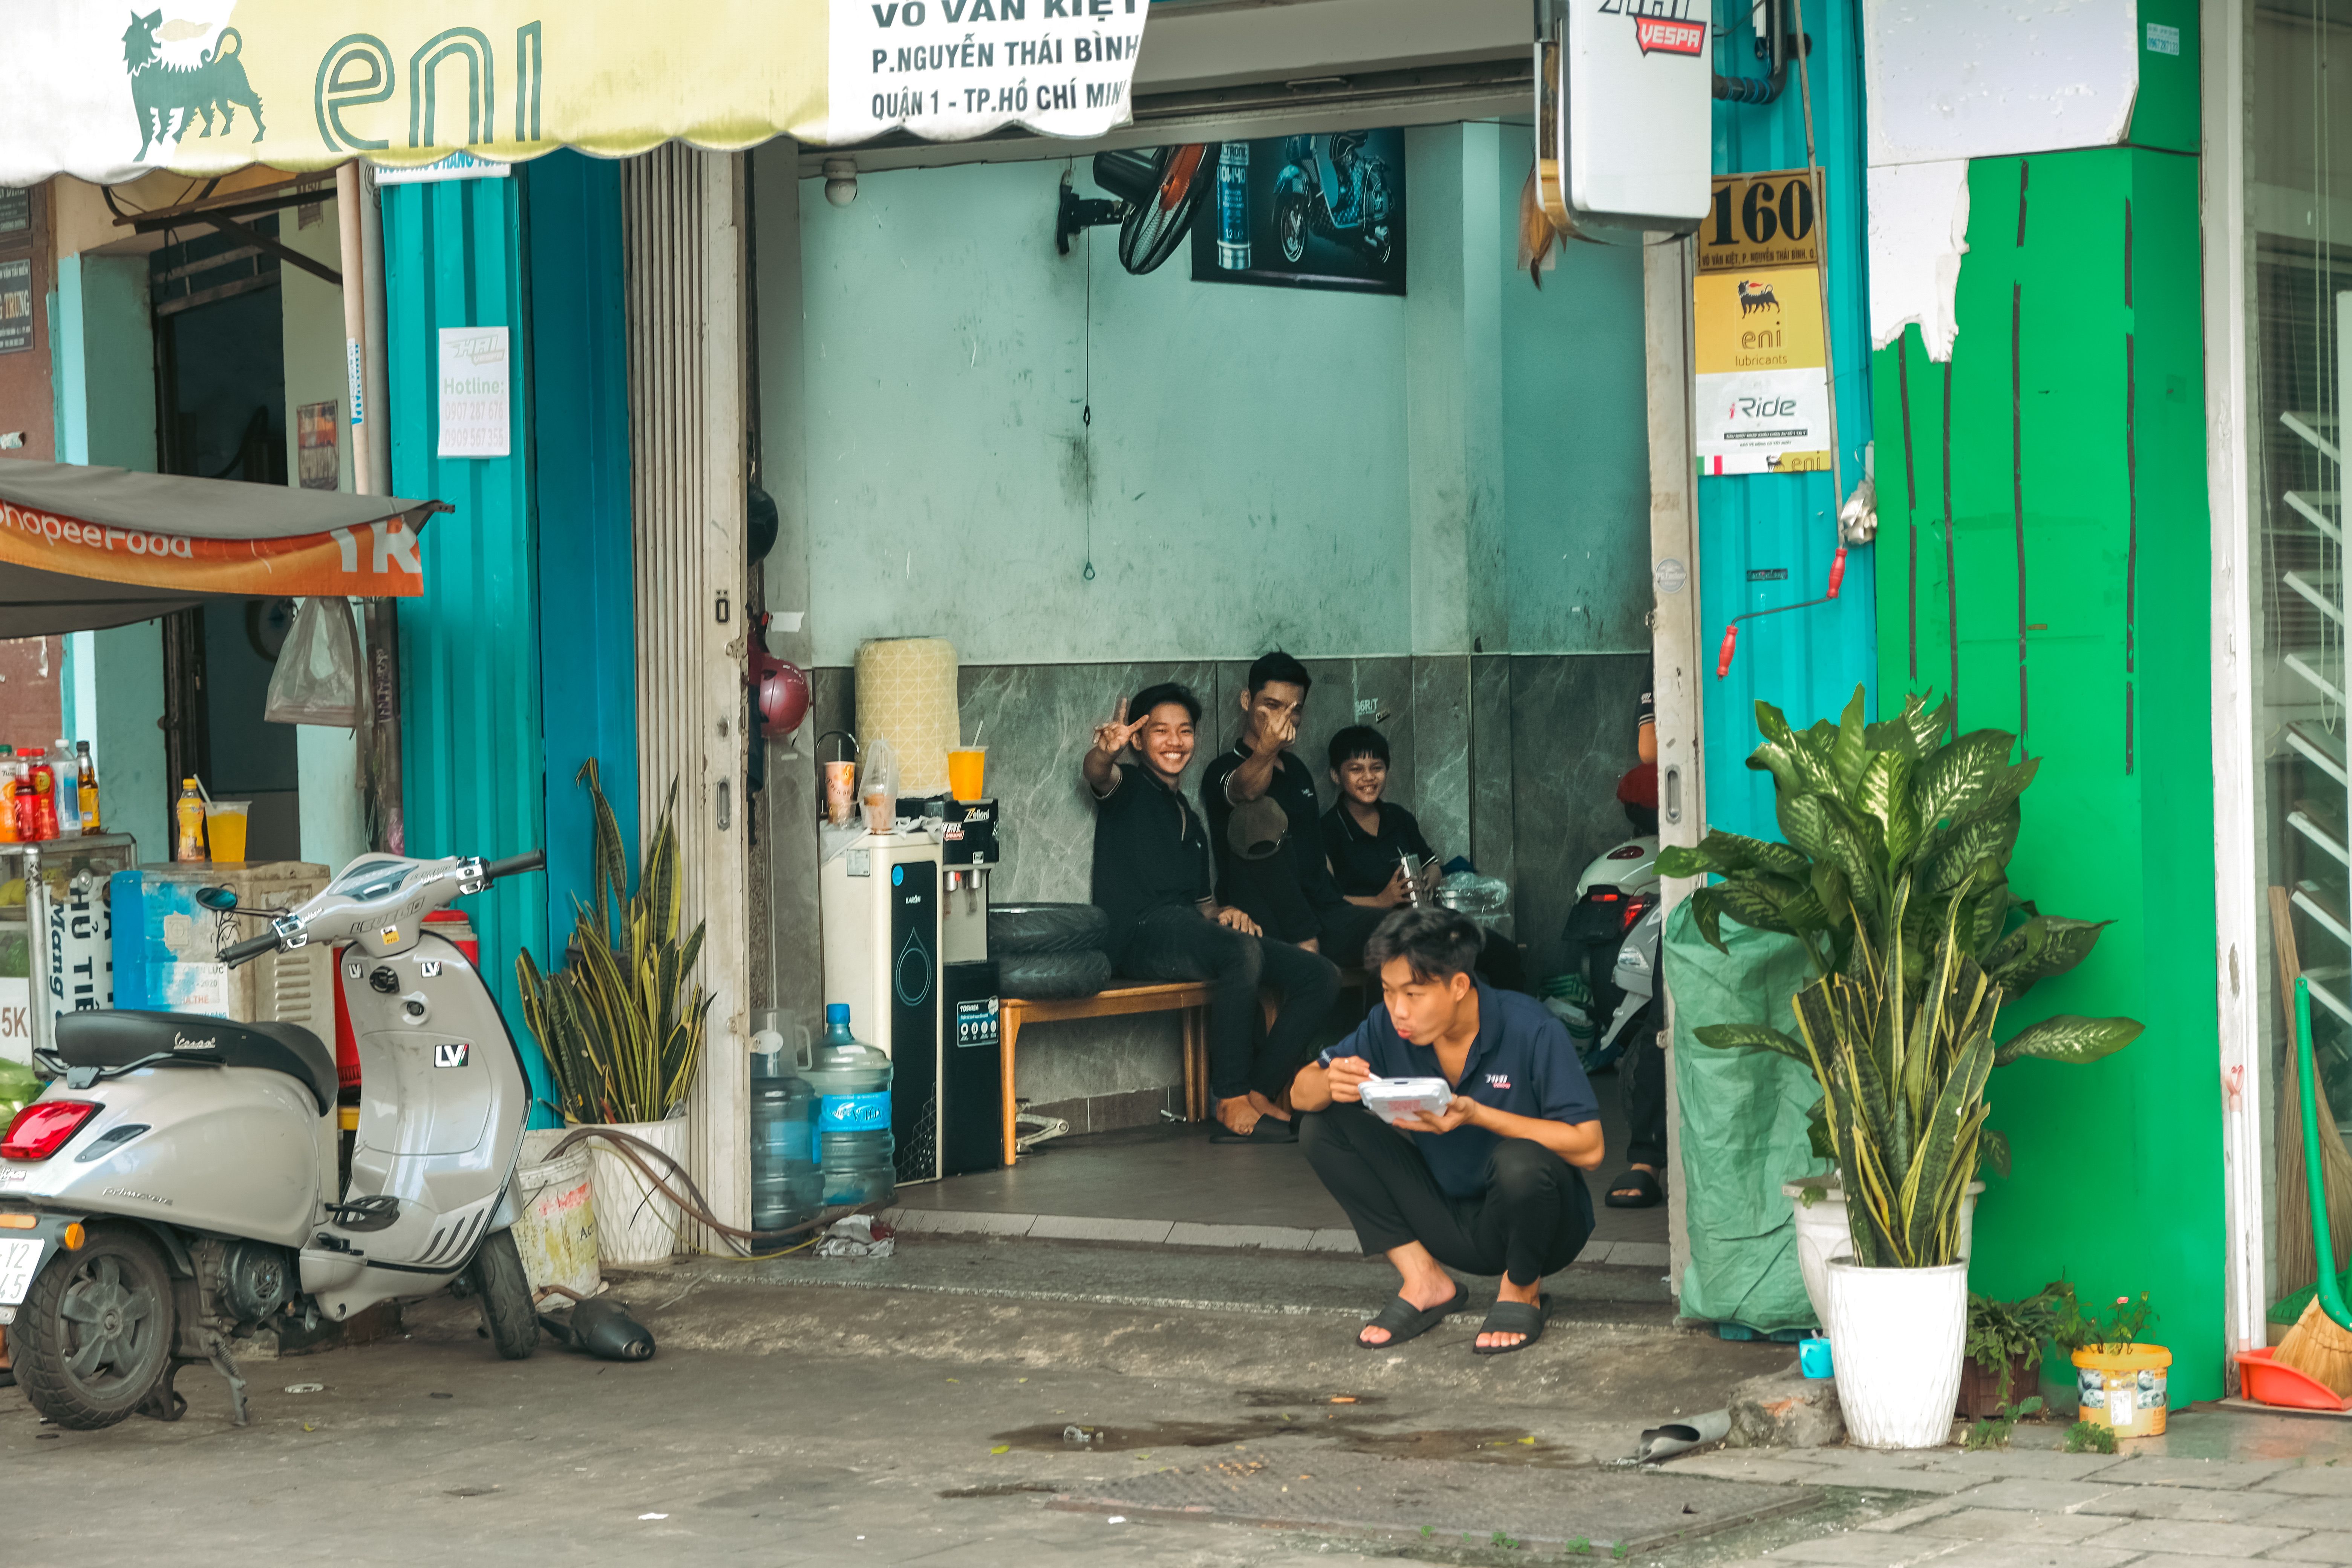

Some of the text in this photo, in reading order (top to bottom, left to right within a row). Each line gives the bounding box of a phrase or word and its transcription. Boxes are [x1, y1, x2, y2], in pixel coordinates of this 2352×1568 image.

[1641, 23, 1701, 47] VESPA
[872, 31, 1139, 74] P.NGUYỄN THÁI BÌNH
[871, 86, 923, 122] QUẬN
[930, 90, 939, 114] 1
[963, 77, 1028, 113] TP.HỒ
[1036, 77, 1076, 110] CHÍ
[1709, 179, 1813, 246] 160
[4, 289, 30, 319] TRUNG
[1742, 321, 1782, 350] eni
[1735, 354, 1788, 367] lubricants
[444, 377, 504, 395] Hotline:
[1792, 450, 1820, 471] eni
[50, 903, 65, 1000] Mang
[174, 1031, 216, 1049] Vespa
[435, 1044, 468, 1067] LV
